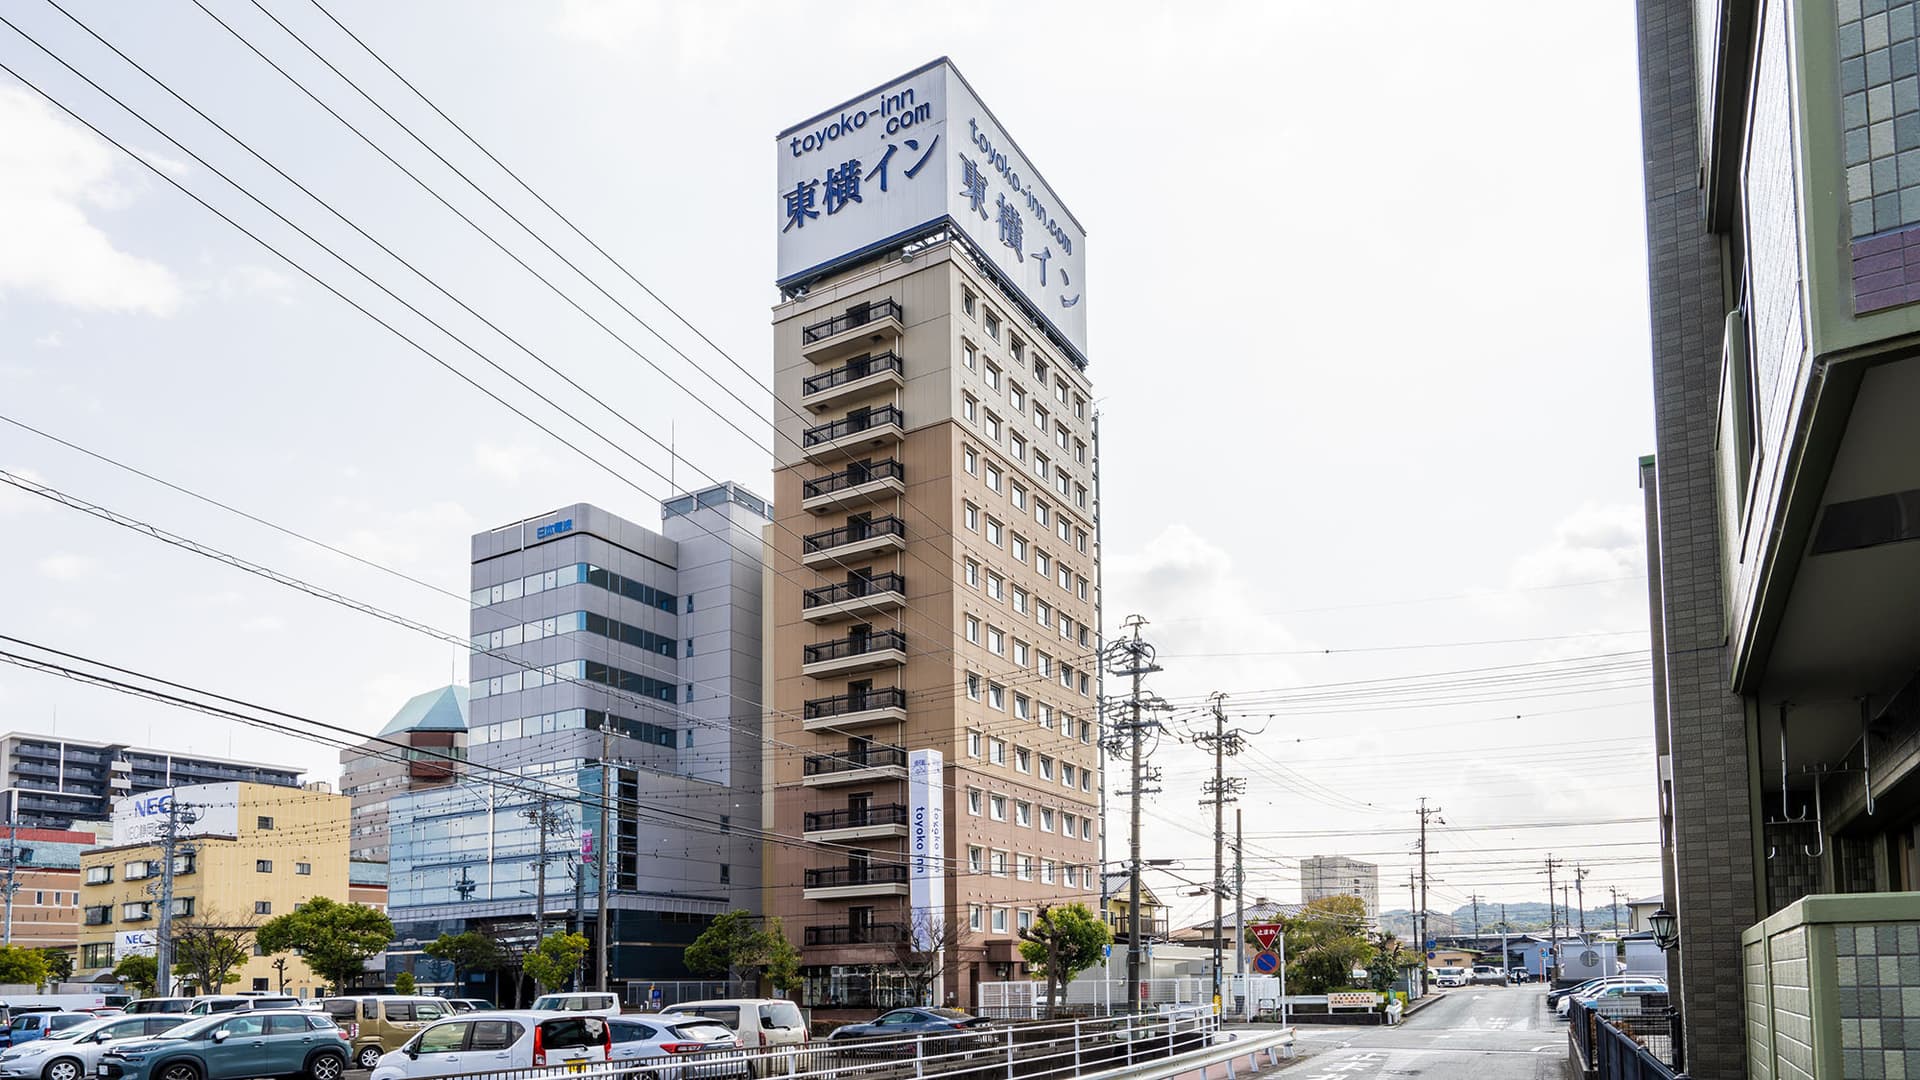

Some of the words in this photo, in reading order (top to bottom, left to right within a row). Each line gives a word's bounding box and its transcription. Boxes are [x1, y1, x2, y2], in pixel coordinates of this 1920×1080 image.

[790, 88, 914, 157] toyoko-inn
[880, 102, 930, 139] .com
[782, 134, 939, 233] 東横イン
[969, 117, 1073, 256] toyoko-inn.com
[959, 152, 1080, 308] 東横イン
[134, 795, 173, 817] NEC
[914, 806, 925, 850] toyoko
[916, 853, 926, 873] inn
[126, 933, 146, 945] NEC
